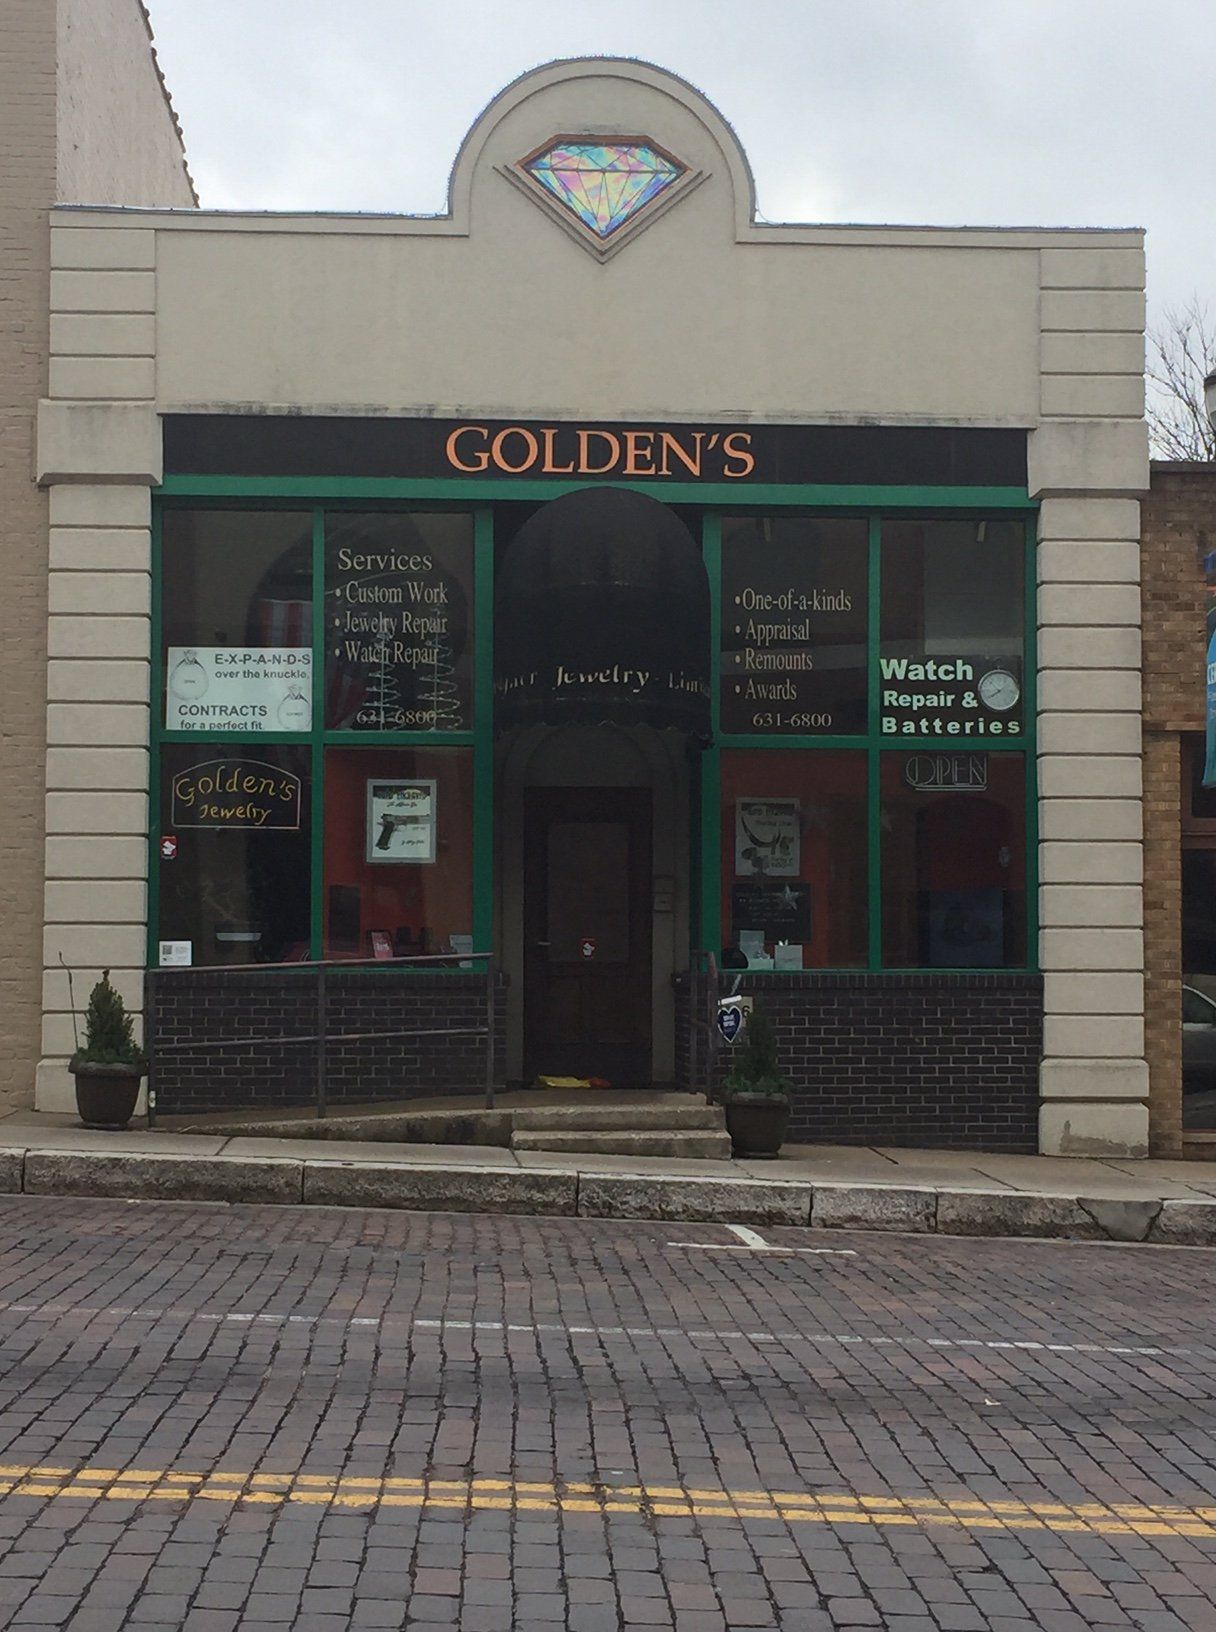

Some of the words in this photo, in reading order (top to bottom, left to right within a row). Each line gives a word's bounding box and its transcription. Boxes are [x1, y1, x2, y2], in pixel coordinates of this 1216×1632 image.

[445, 426, 756, 478] GOLDEN'S
[337, 548, 433, 572] Services
[345, 581, 403, 604] Custom
[407, 583, 449, 604] Work
[742, 588, 852, 611] One-of-a-kinds
[343, 611, 397, 638] Jewelry
[401, 611, 448, 639] Repair
[744, 618, 810, 645] Appraisal
[214, 653, 311, 665] E-X-P-A-N-D-S
[345, 641, 391, 664] Watch
[394, 641, 440, 669] Repair
[745, 648, 813, 670] Remounts
[214, 671, 240, 679] over
[243, 670, 260, 679] the
[552, 664, 650, 693] Jewelry
[880, 658, 973, 681] Watch
[744, 679, 797, 701] Awards
[883, 690, 956, 711] Repair
[961, 690, 978, 708] &
[178, 704, 268, 717] CONTRACTS
[752, 712, 832, 728] 631-6800
[180, 720, 196, 730] for
[209, 720, 248, 731] perfect
[881, 717, 1020, 734] Batteries
[905, 755, 987, 785] OPEN
[175, 764, 295, 807] Golden's
[200, 803, 272, 824] Jewelry
